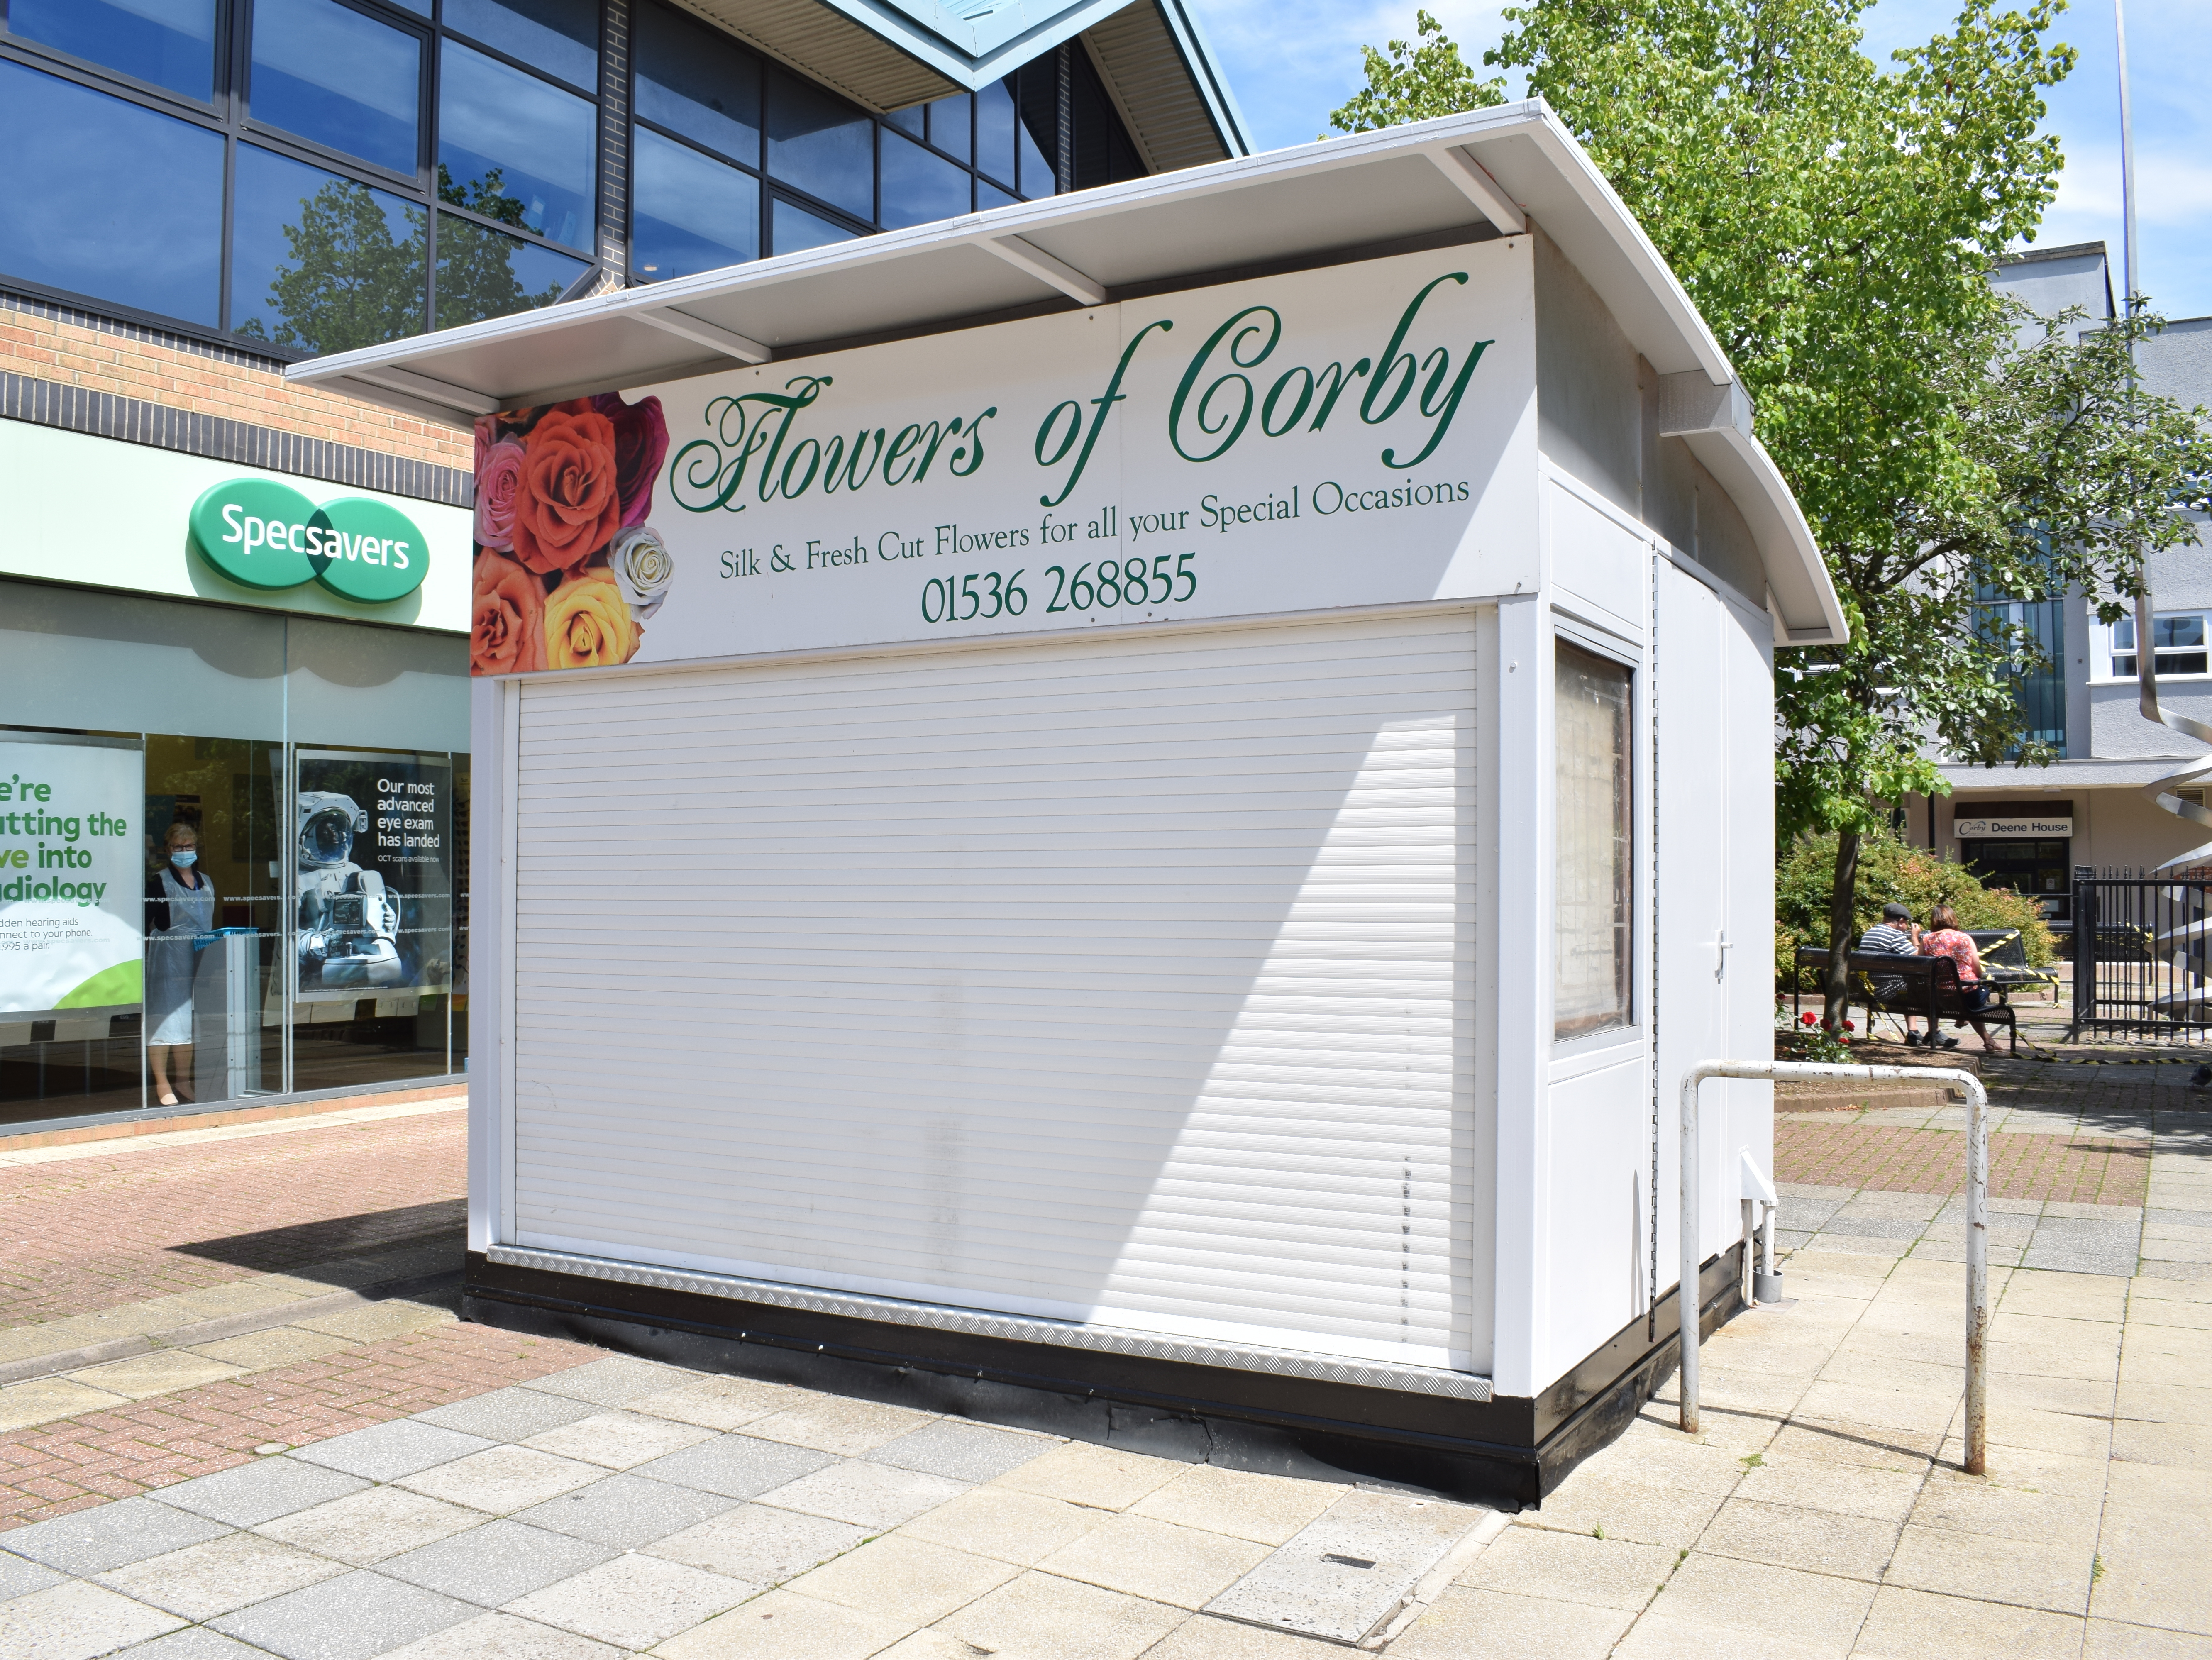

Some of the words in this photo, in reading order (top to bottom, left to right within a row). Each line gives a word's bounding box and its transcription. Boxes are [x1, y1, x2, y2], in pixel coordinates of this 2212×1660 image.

[670, 376, 997, 513] Flowers
[1035, 320, 1173, 507] of
[1168, 272, 1495, 469] Corby
[222, 504, 410, 569] Specsavers
[720, 548, 762, 579] Silk
[771, 544, 796, 573] &
[806, 536, 868, 569] Fresh
[878, 531, 924, 561] Cut
[935, 524, 1029, 555] Flowers
[1040, 513, 1078, 544] for
[1088, 505, 1118, 539] all
[1129, 510, 1189, 542] your
[1200, 485, 1300, 534] Special
[1312, 478, 1470, 515] Occasions
[921, 569, 1028, 623] 01536
[1044, 552, 1196, 613] 268855
[377, 779, 404, 793] Our
[408, 783, 435, 795] most
[377, 796, 434, 813] advanced
[0, 808, 80, 842] tting
[87, 811, 127, 837] the
[378, 817, 401, 832] eye
[404, 818, 434, 830] exam
[1992, 823, 2027, 832] Deene
[2032, 822, 2068, 831] House
[378, 832, 401, 847] has
[404, 832, 440, 847] landed
[38, 842, 92, 868] into
[0, 874, 107, 907] diology
[26, 918, 60, 928] hearing
[63, 917, 78, 926] aids
[43, 930, 63, 940] your
[66, 928, 93, 939] phone.
[32, 941, 50, 952] pair.
